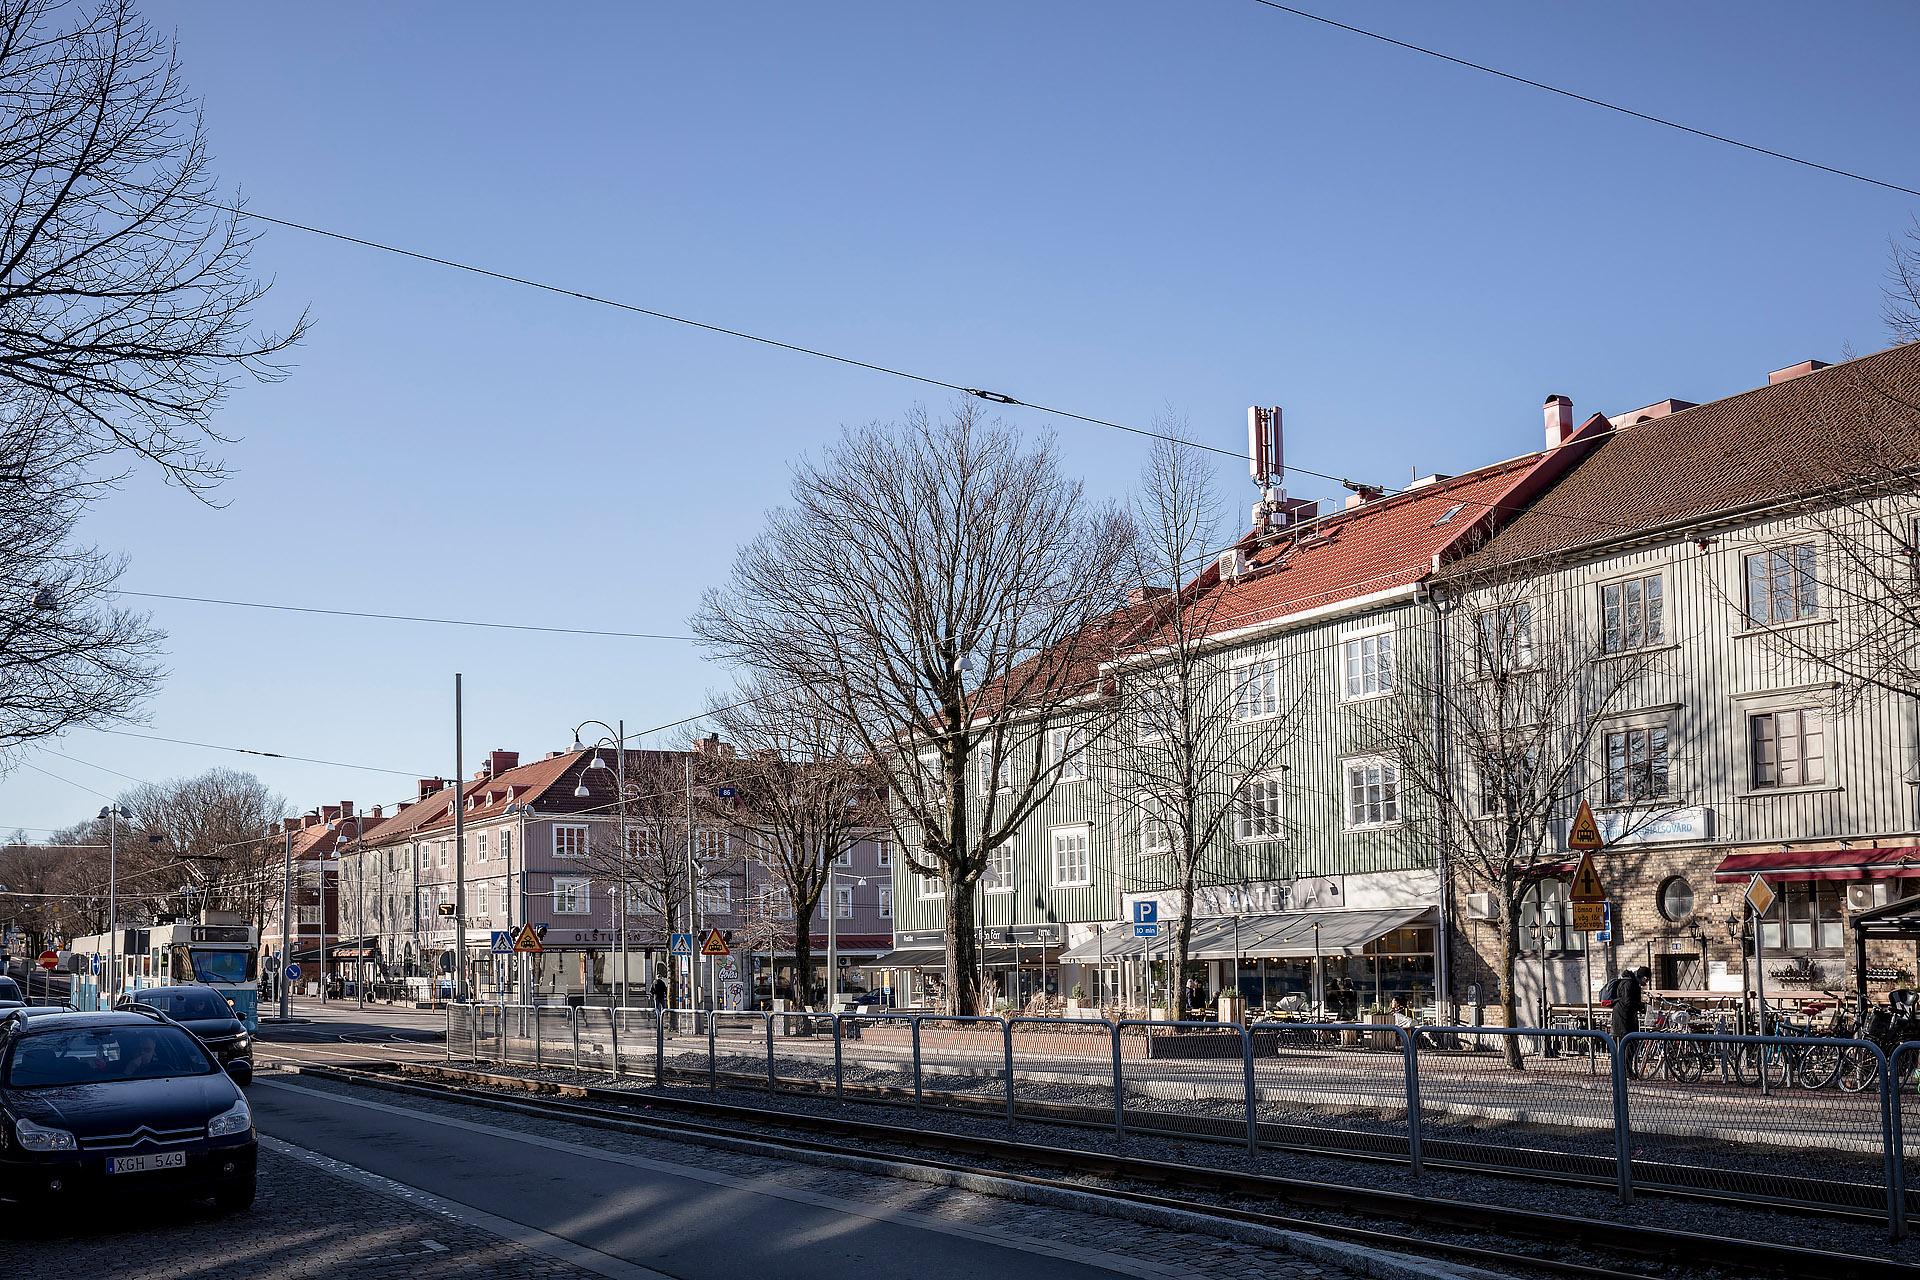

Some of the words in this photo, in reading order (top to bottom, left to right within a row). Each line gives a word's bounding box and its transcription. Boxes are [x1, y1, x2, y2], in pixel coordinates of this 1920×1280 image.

[1226, 884, 1319, 908] MATERIA
[1140, 903, 1152, 922] P
[193, 928, 206, 941] 11
[117, 1157, 145, 1172] XGH
[155, 1153, 183, 1168] 549
